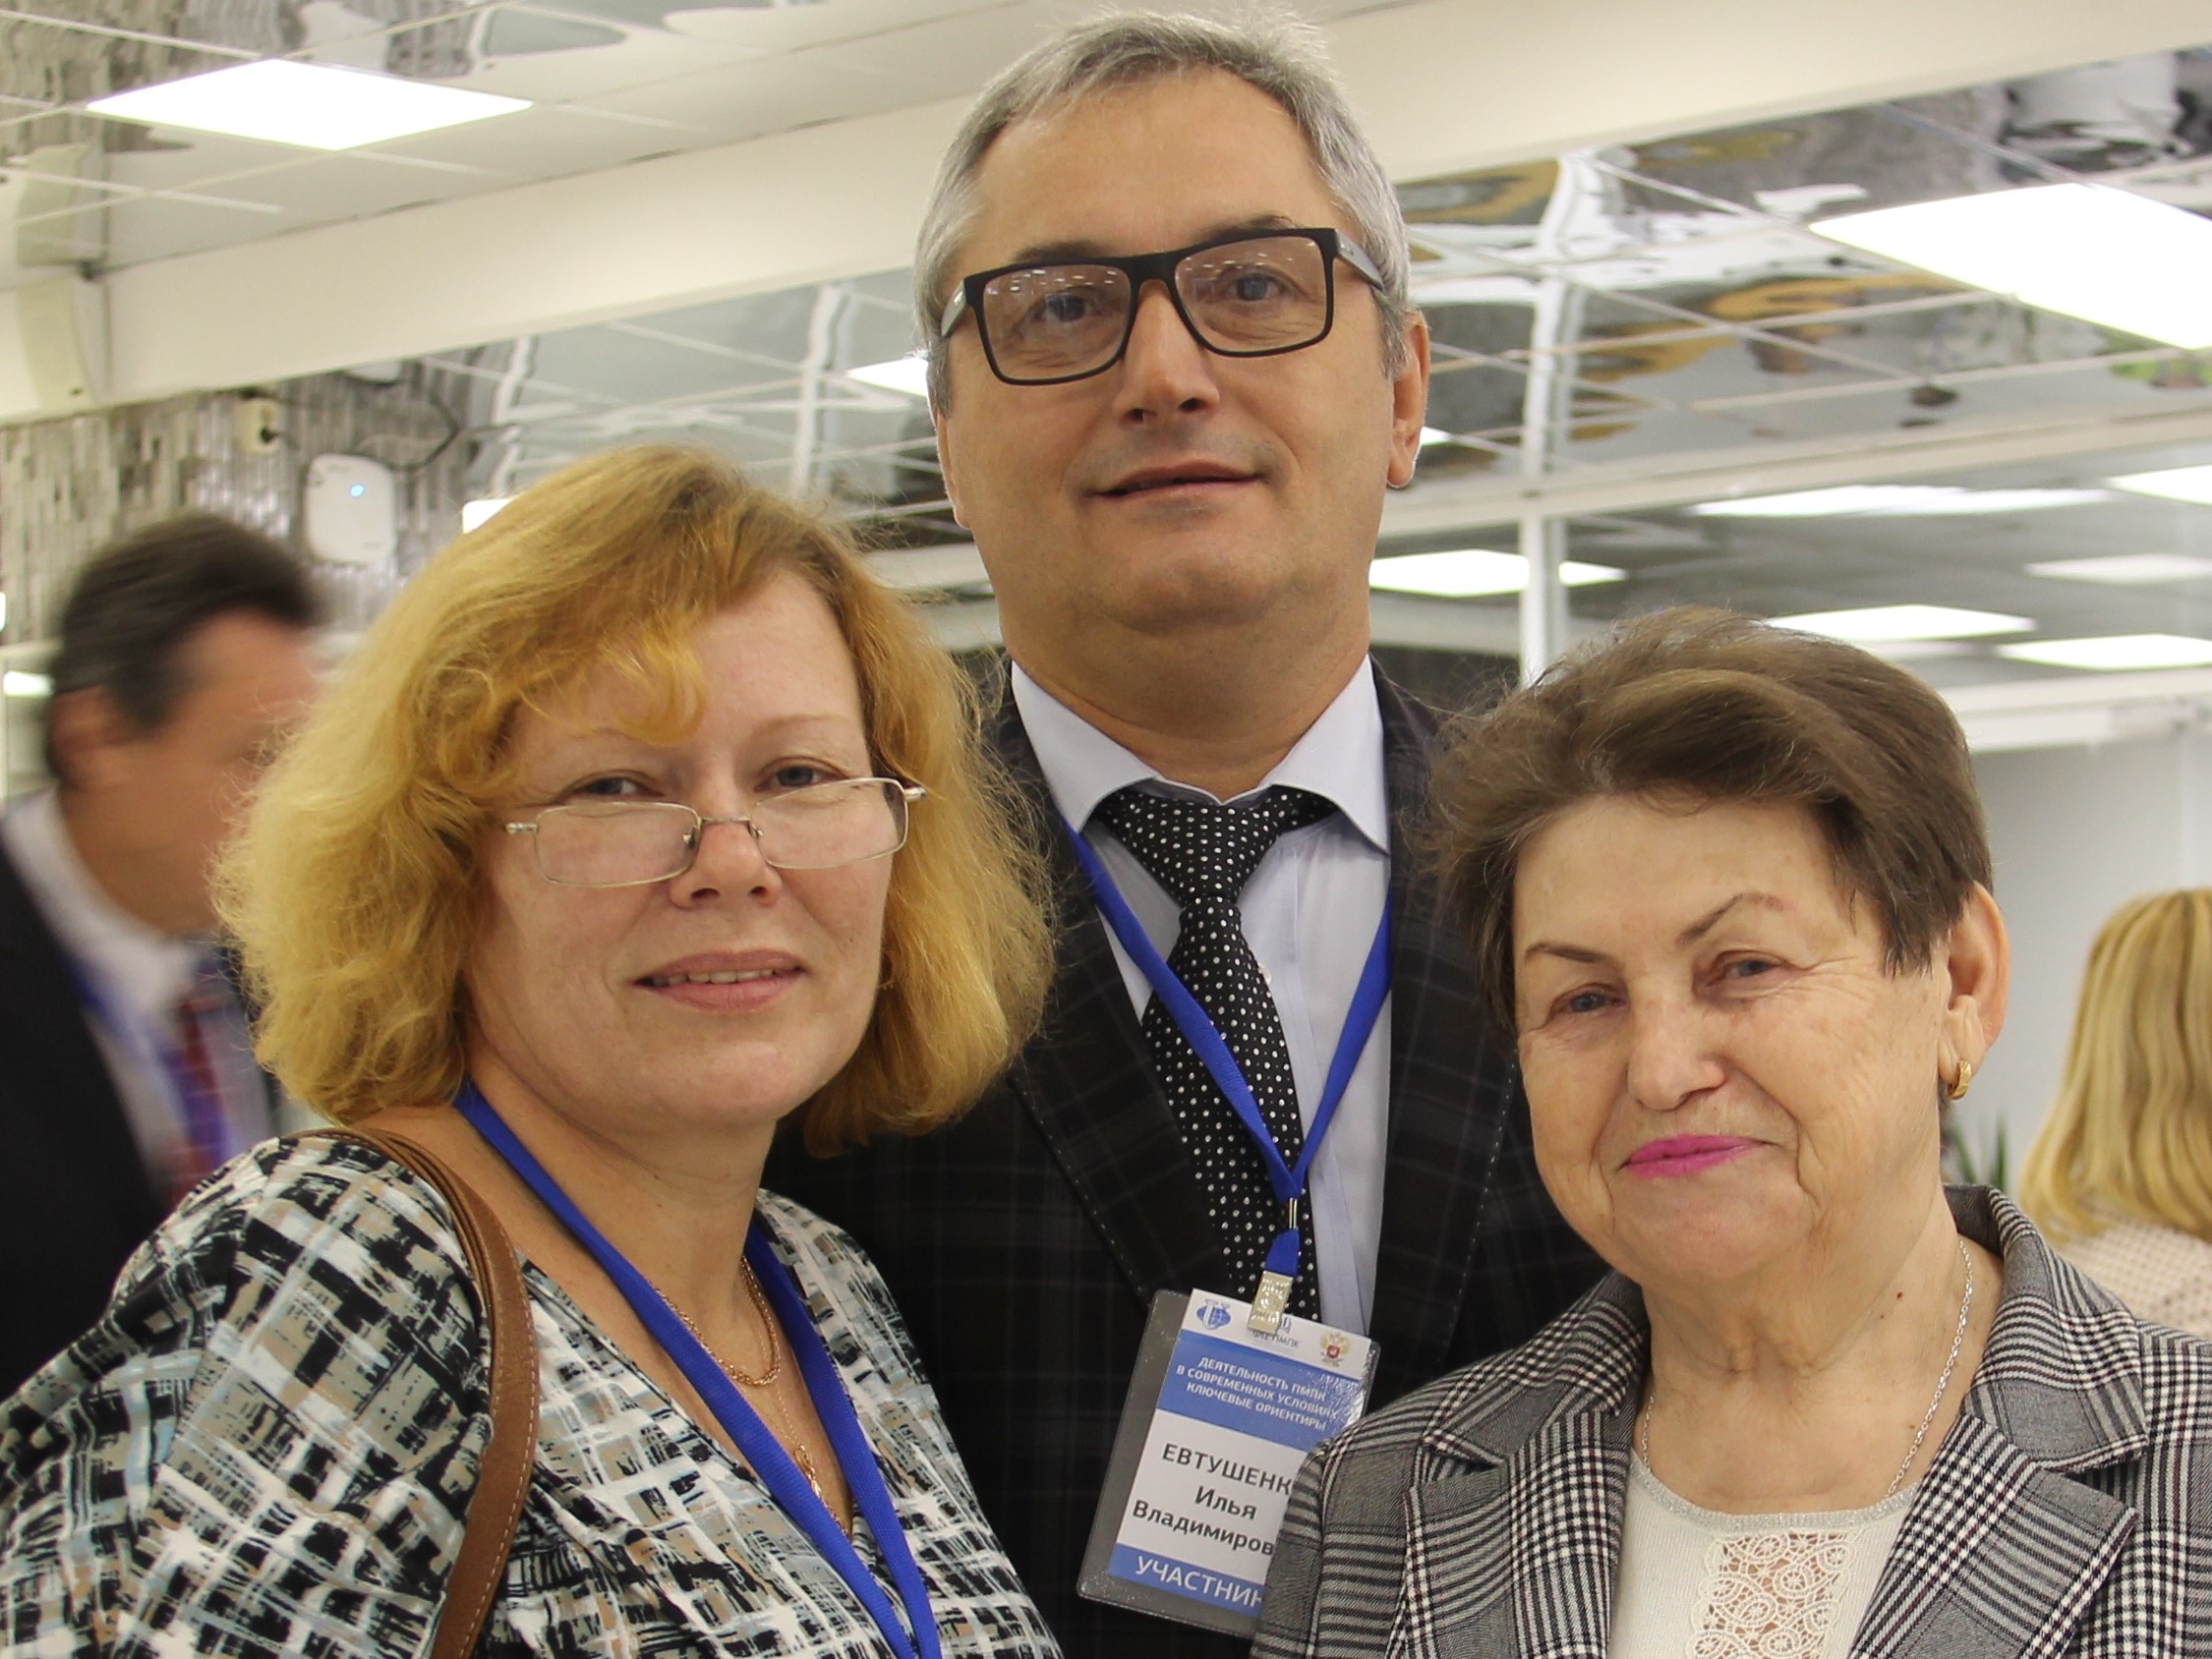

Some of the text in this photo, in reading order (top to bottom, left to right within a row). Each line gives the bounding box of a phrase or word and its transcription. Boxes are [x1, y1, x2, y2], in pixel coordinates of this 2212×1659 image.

[1177, 1365, 1185, 1375] В
[1188, 1368, 1274, 1401] СОВРЕМЕННЫХ
[1197, 1357, 1326, 1402] ДЕЯТЕЛЬНОСТЬ ПМПК
[1186, 1382, 1327, 1431] КЛЮЧЕВЫЕ ОРИЕНТИРЫ
[1194, 1485, 1257, 1520] Илья
